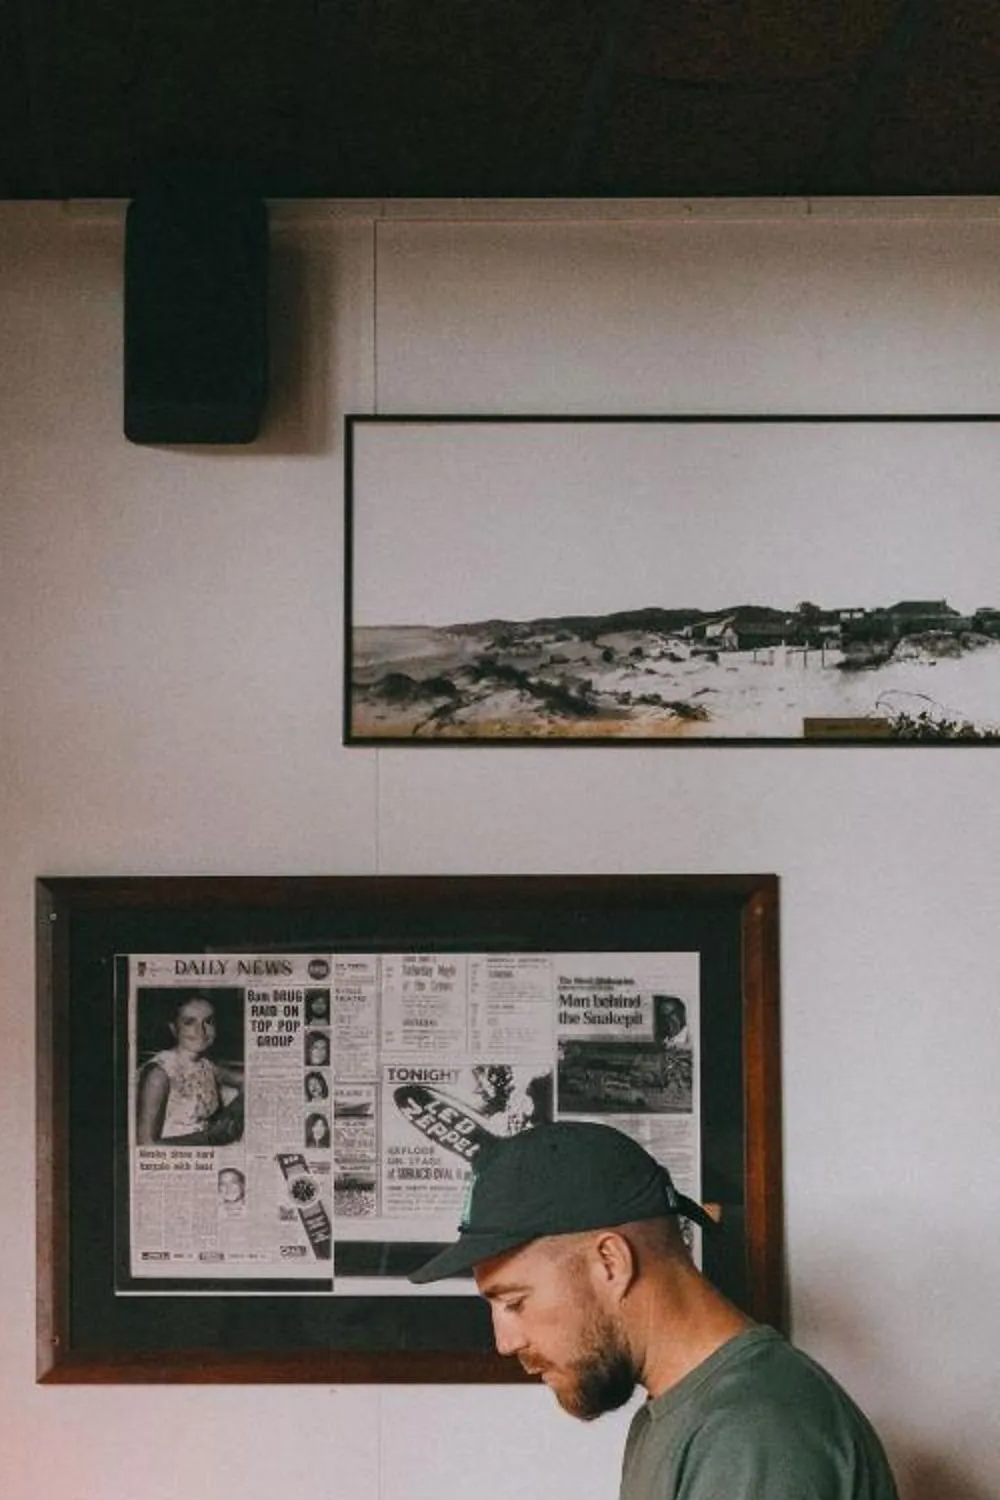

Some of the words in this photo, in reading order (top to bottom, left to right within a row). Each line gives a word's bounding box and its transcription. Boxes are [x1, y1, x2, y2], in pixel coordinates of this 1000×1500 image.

[174, 959, 229, 976] DAILY
[237, 959, 293, 976] NEWS
[272, 989, 303, 1002] DRUG
[558, 993, 590, 1008] Man
[592, 993, 641, 1008] behind
[251, 1005, 278, 1018] RAID
[283, 1005, 299, 1018] ON
[251, 1020, 273, 1032] TOP
[277, 1020, 300, 1033] POP
[558, 1011, 581, 1024] the
[583, 1011, 643, 1029] Snakepit
[256, 1035, 295, 1047] GROUP
[387, 1068, 462, 1081] TONIGHT
[423, 1100, 477, 1135] LED
[401, 1097, 480, 1157] ZEPPEL
